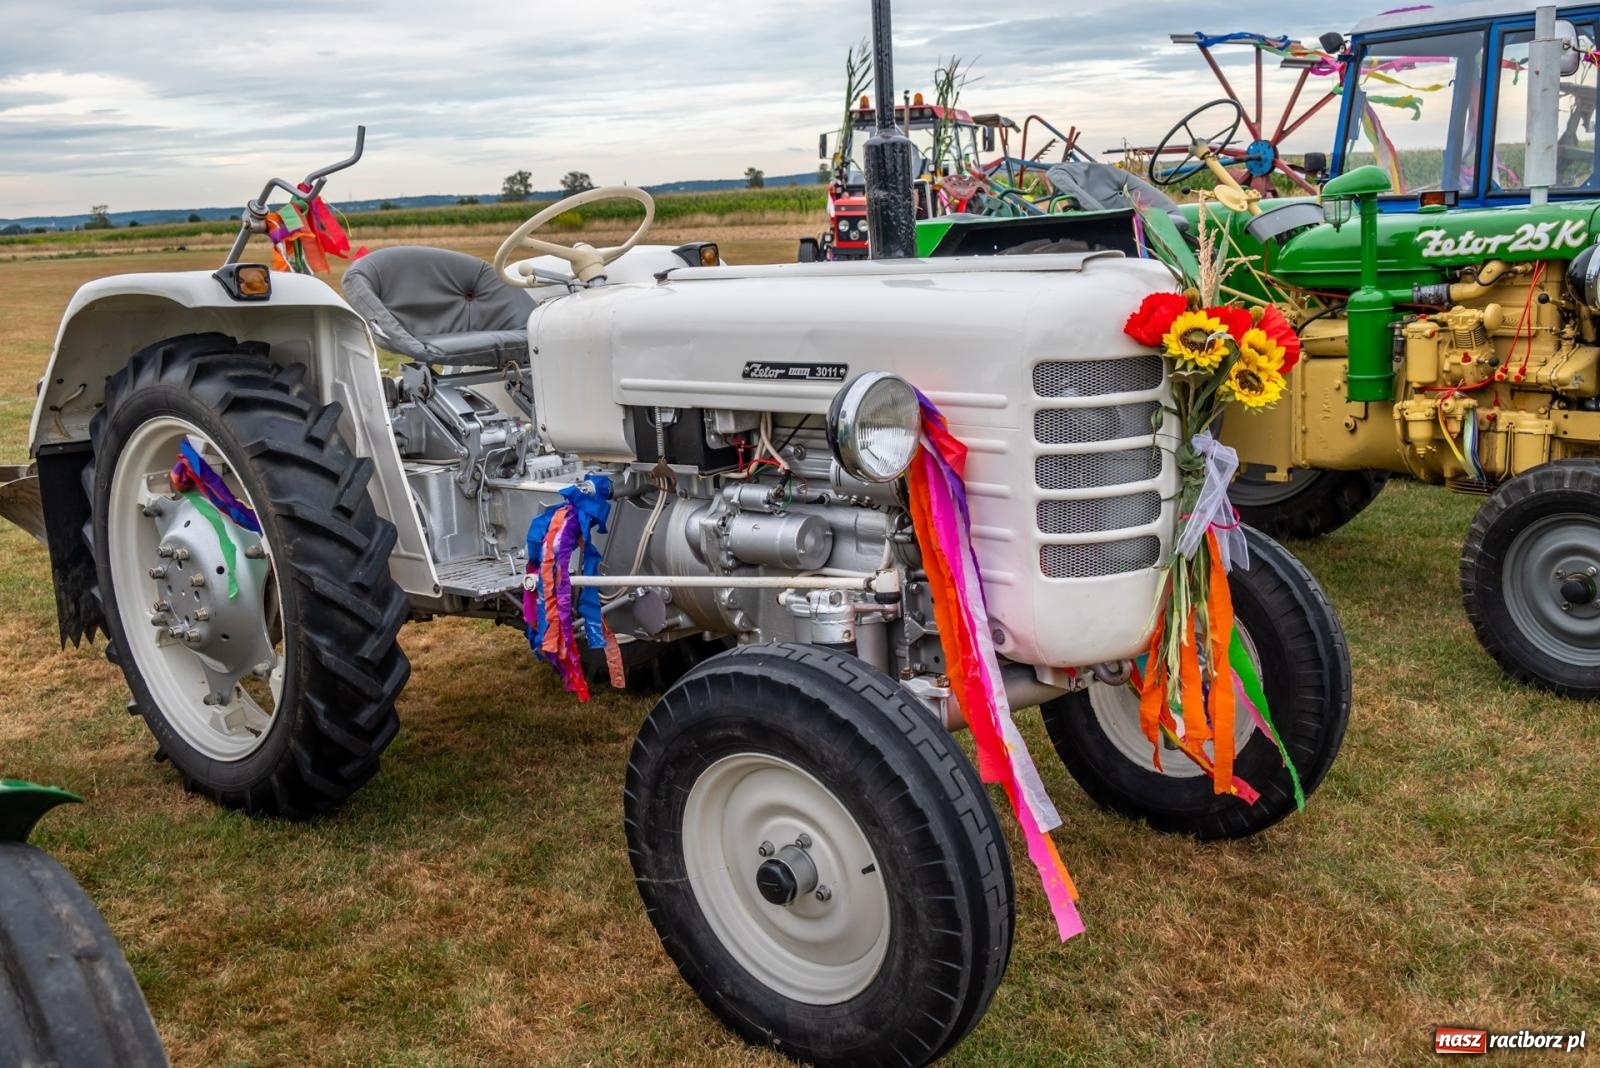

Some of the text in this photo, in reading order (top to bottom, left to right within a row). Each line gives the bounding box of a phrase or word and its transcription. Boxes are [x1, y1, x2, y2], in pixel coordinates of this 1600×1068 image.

[1415, 229, 1516, 257] Zetor
[750, 364, 785, 378] Zetor
[816, 367, 837, 376] 3011
